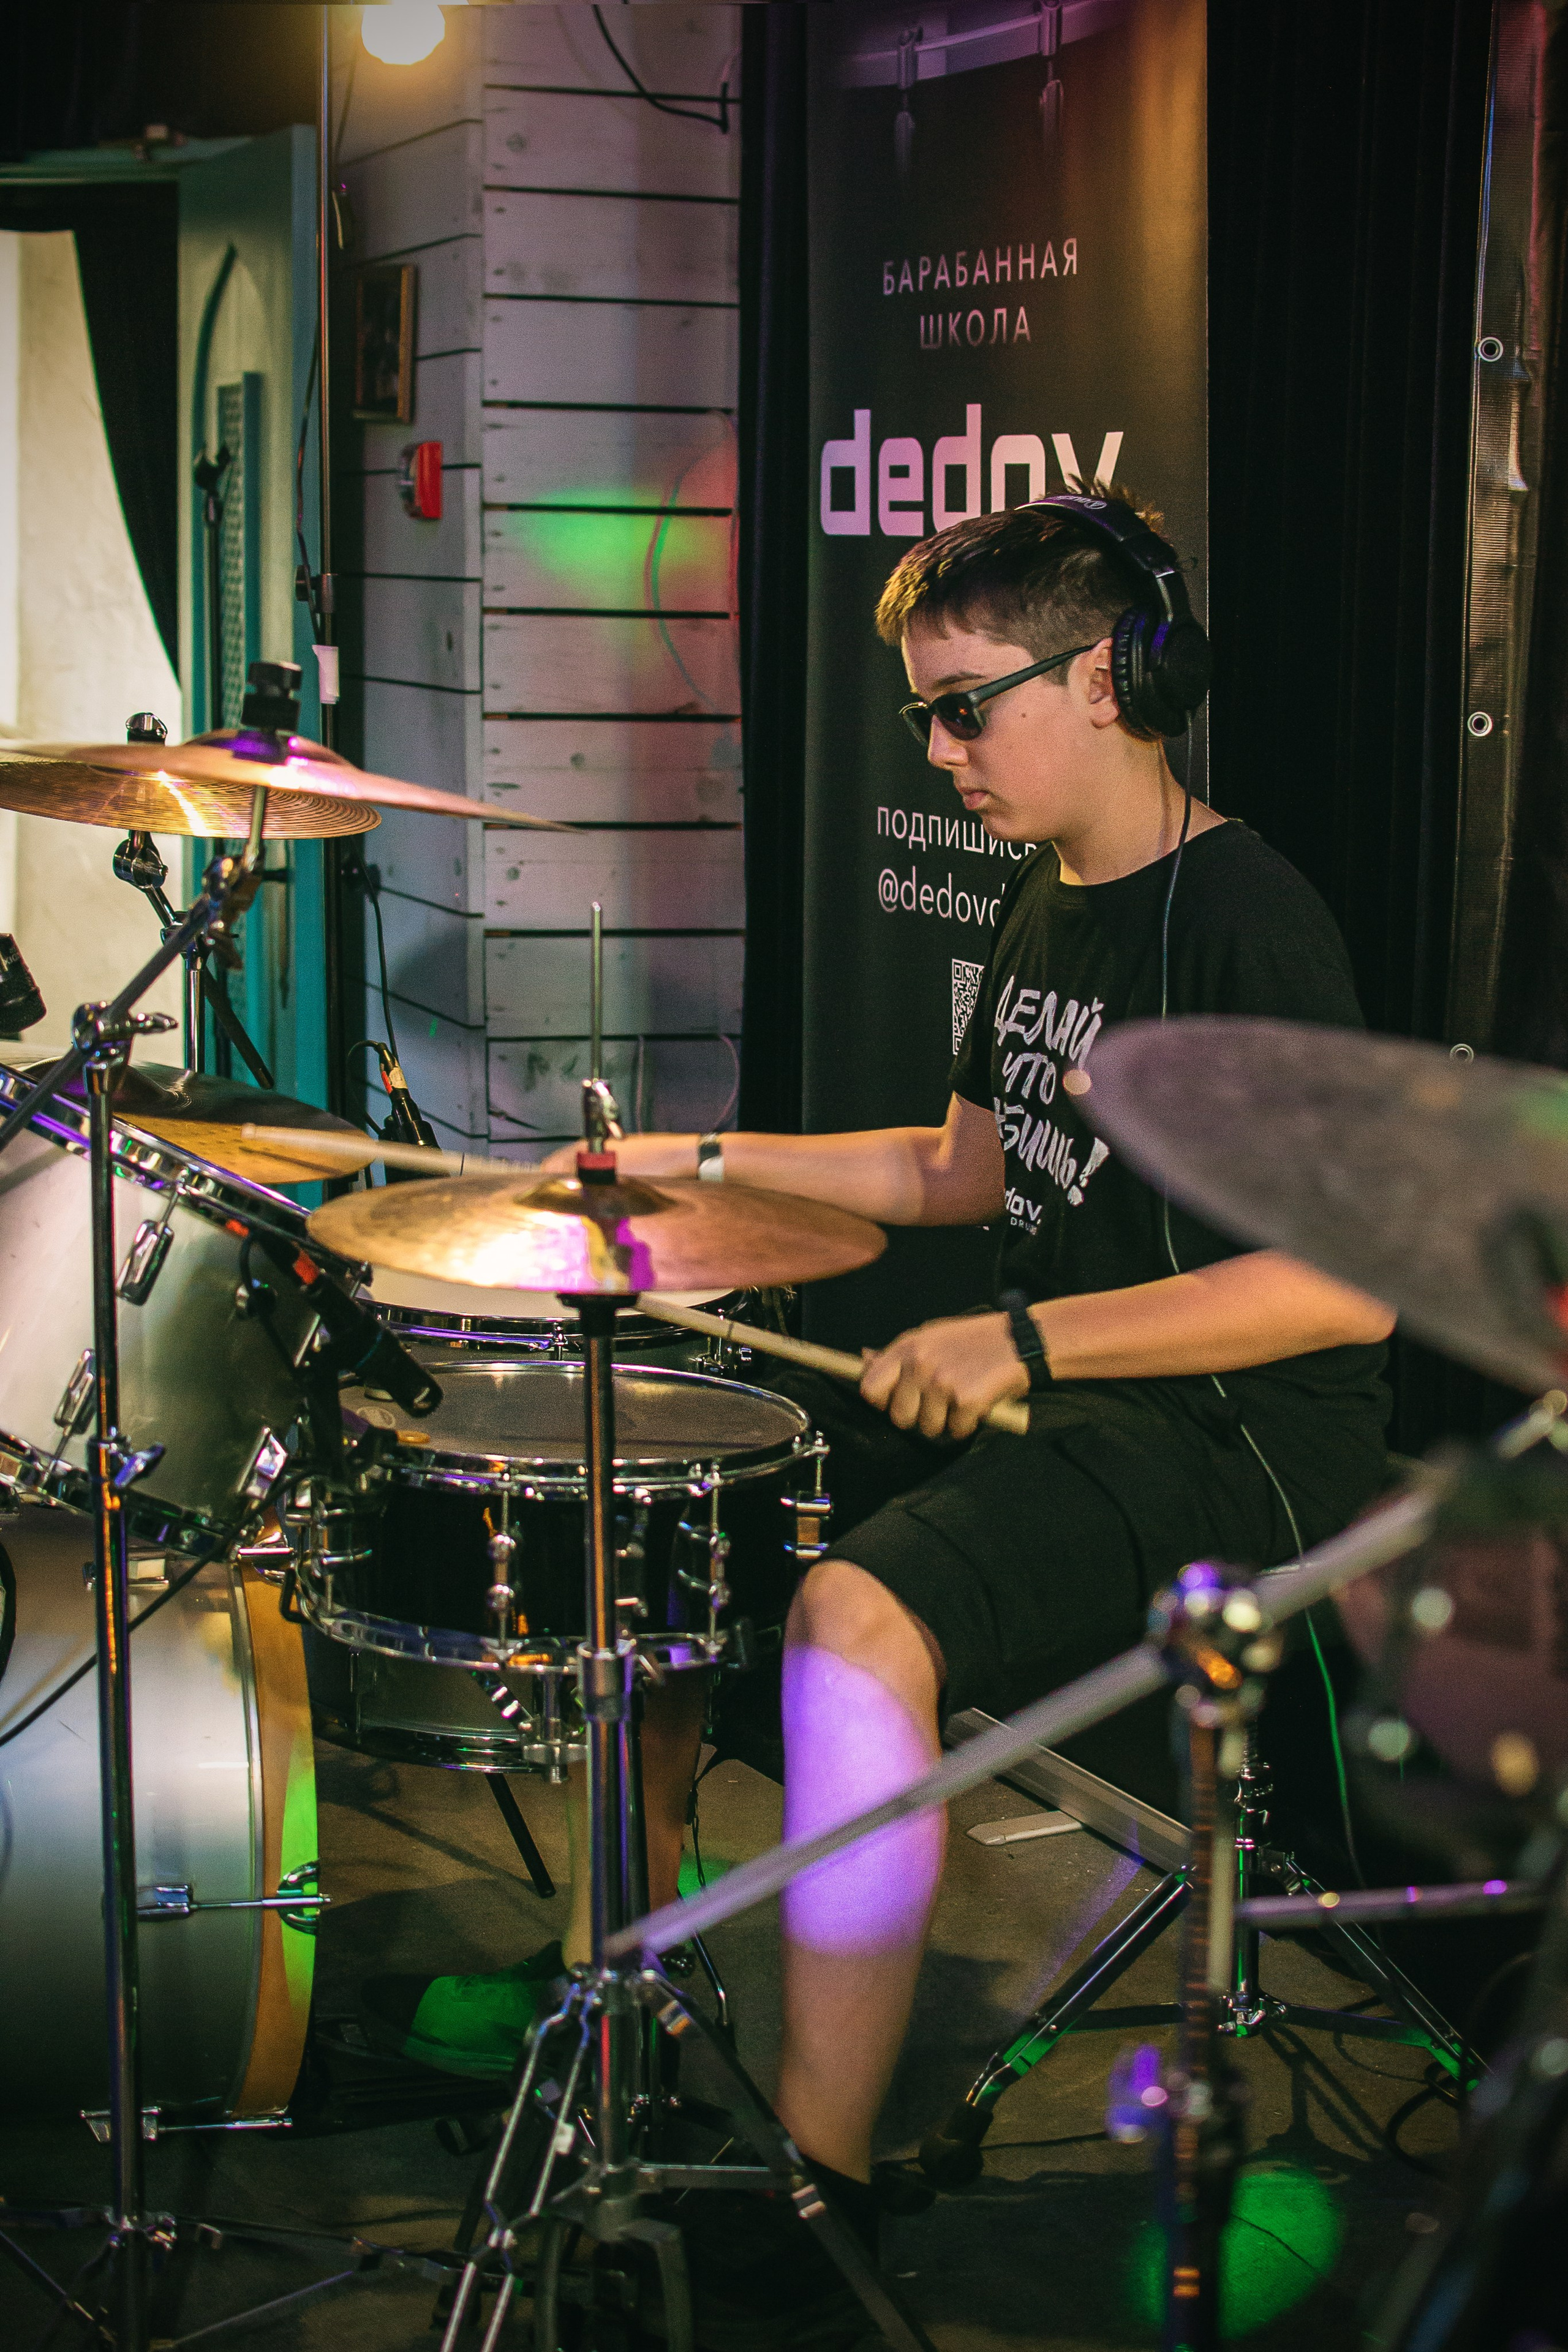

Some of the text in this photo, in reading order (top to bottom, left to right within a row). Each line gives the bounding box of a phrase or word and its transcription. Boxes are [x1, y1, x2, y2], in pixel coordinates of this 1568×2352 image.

[883, 238, 1078, 296] БАРАБАННАЯ
[919, 306, 1031, 349] ШКОЛА
[994, 974, 1104, 1070] ДЕЛАЙ
[1002, 1051, 1057, 1105] ЧТО
